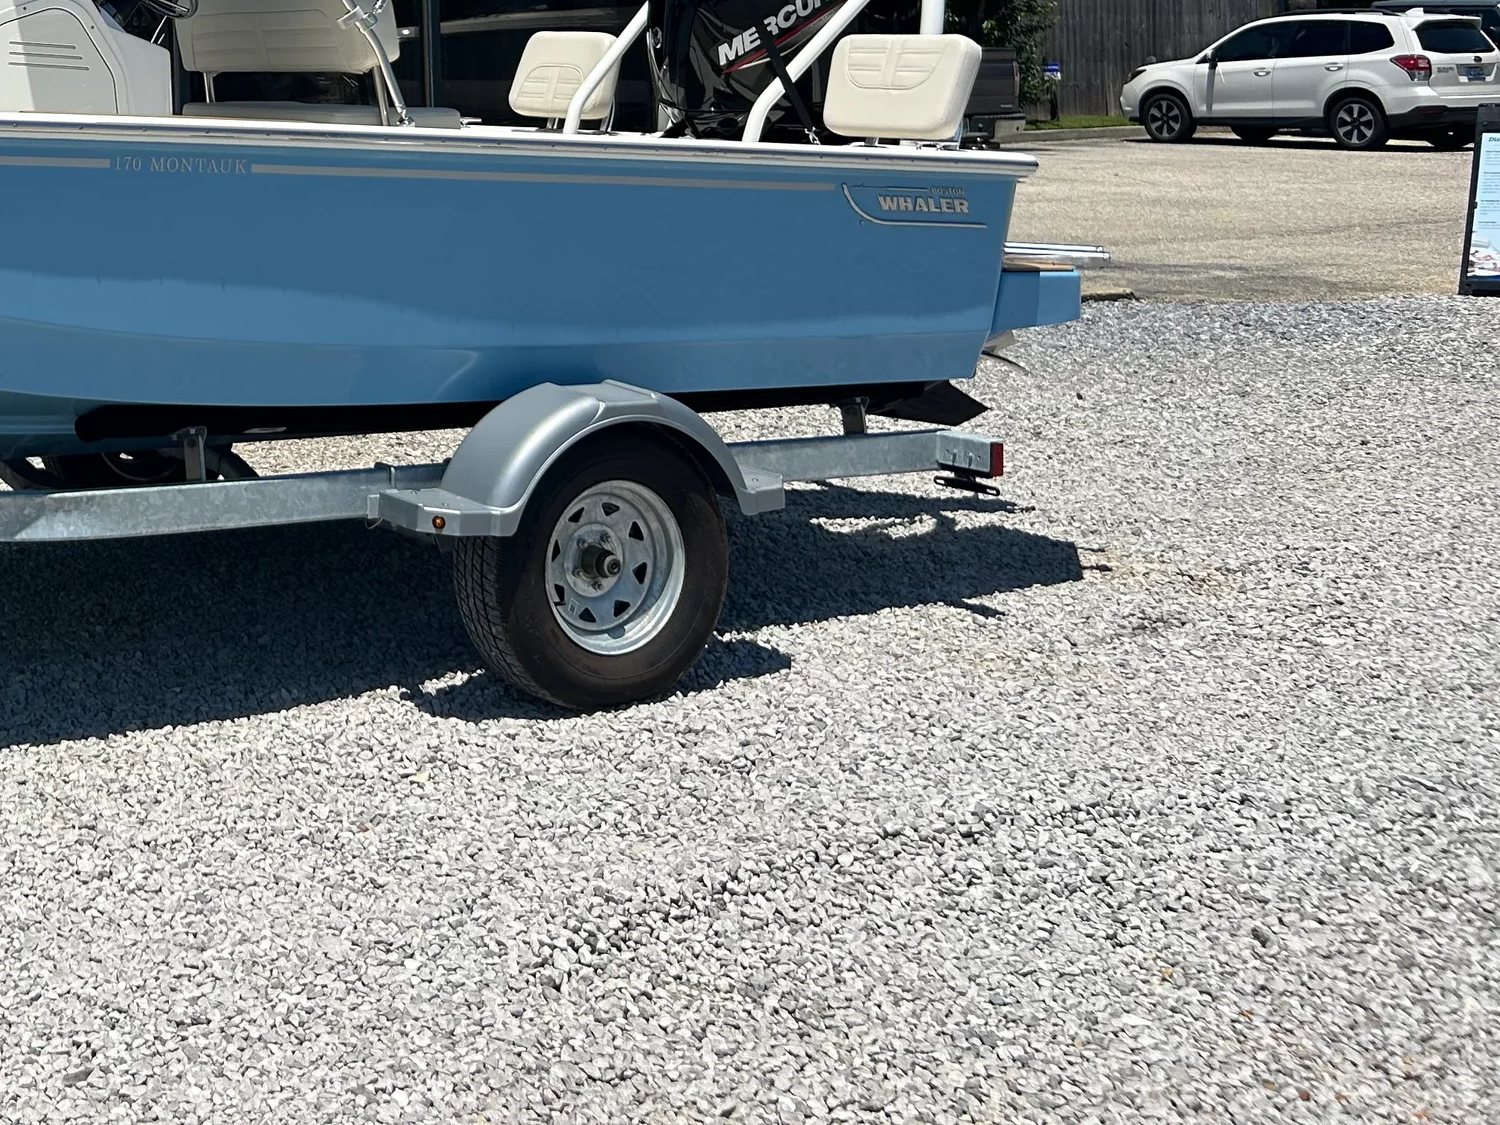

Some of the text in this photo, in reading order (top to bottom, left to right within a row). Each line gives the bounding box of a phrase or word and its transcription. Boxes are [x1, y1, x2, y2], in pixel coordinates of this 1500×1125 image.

[115, 156, 248, 174] 170 MONTAUK
[930, 186, 965, 196] BOSTON
[877, 194, 969, 214] WHALER
